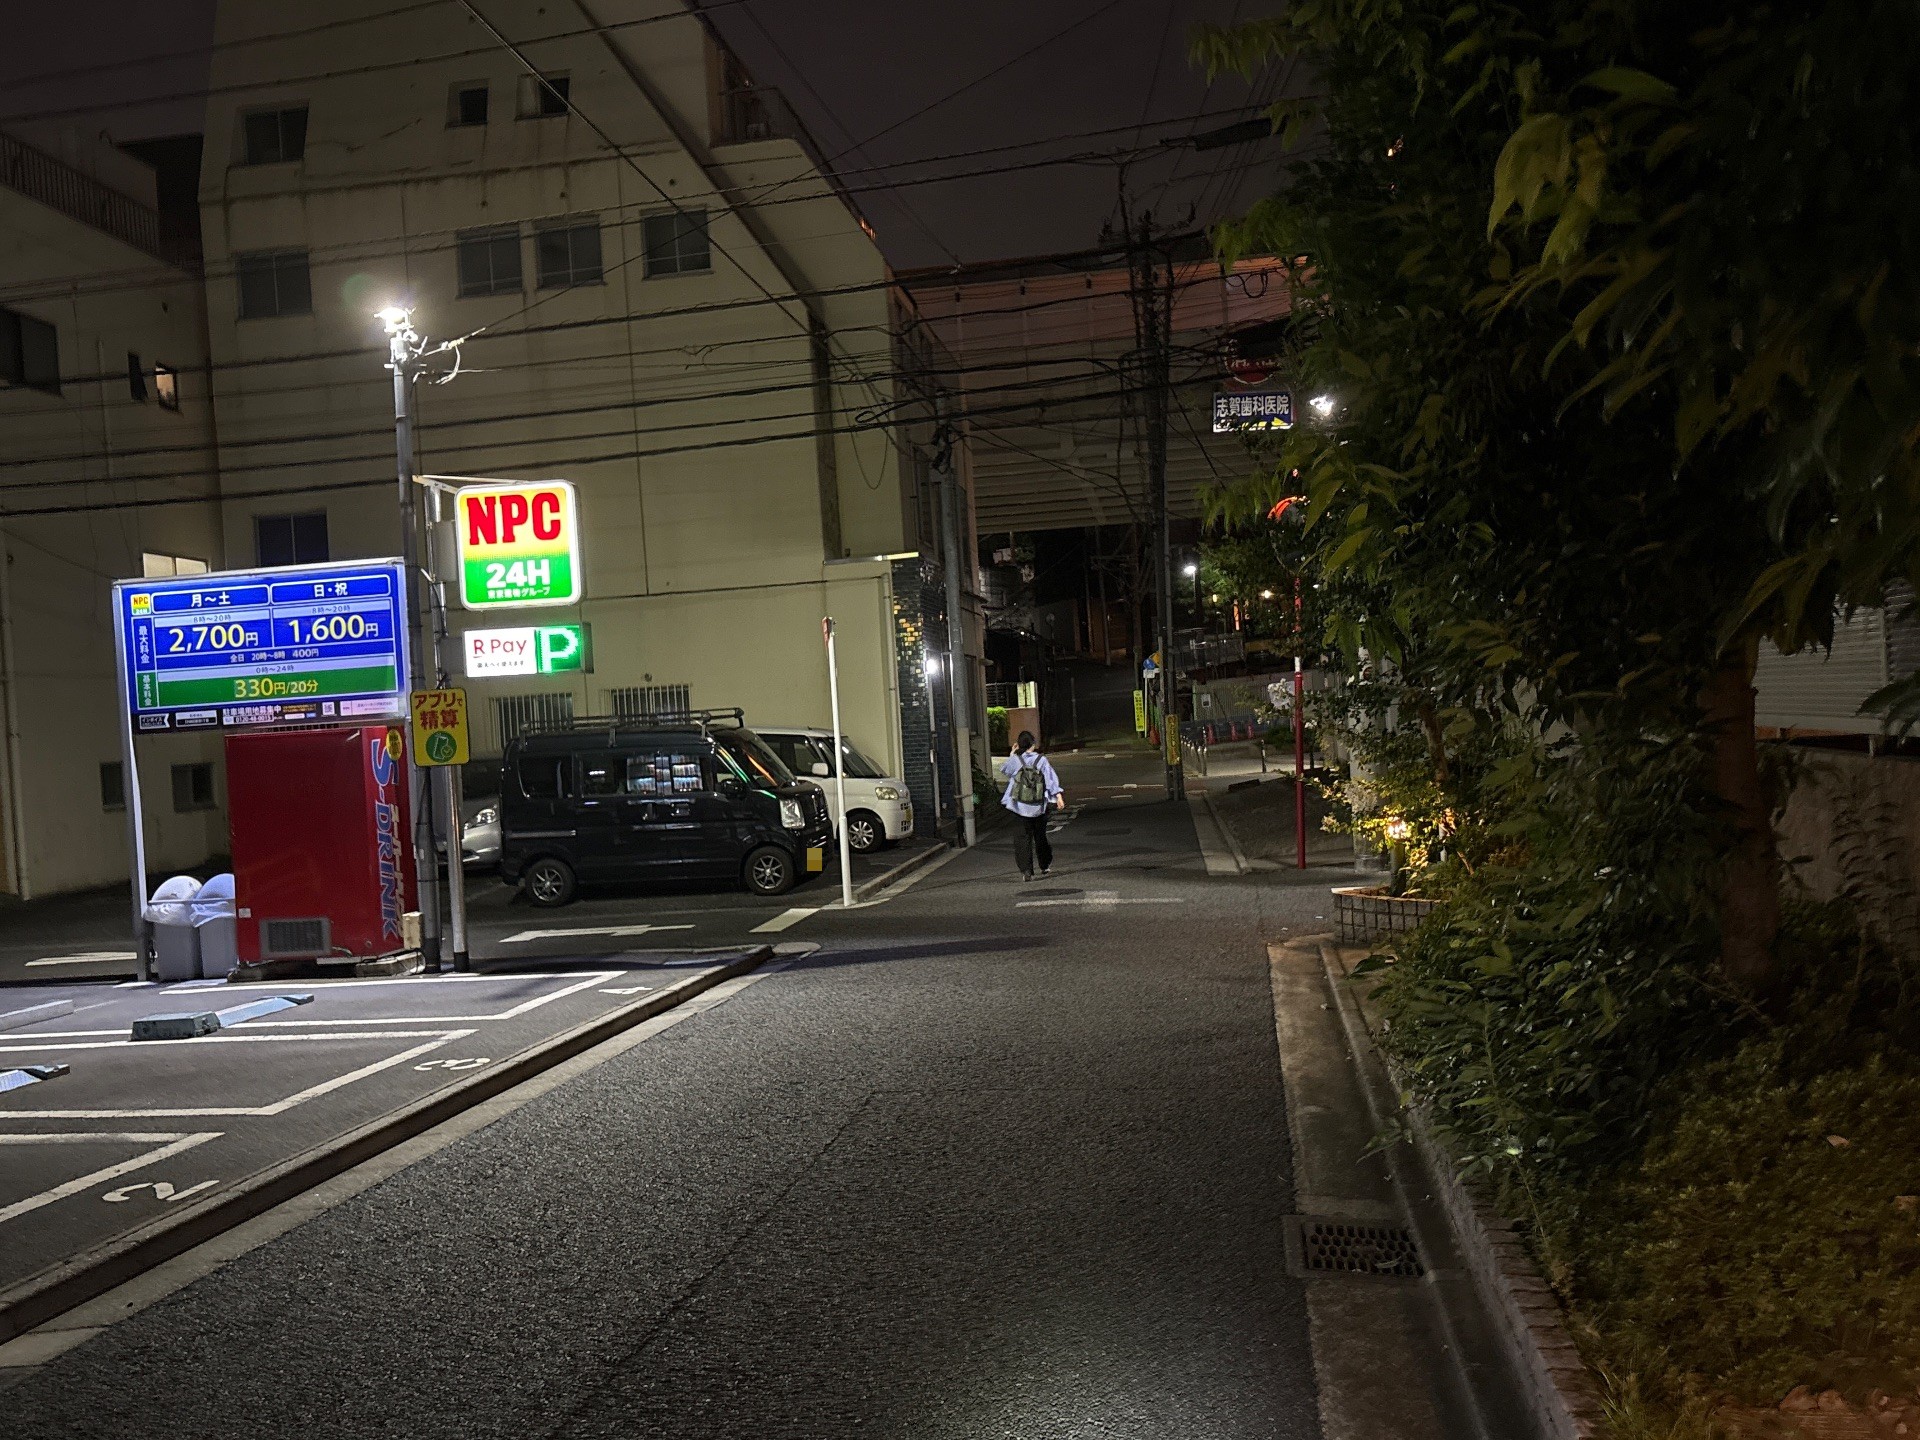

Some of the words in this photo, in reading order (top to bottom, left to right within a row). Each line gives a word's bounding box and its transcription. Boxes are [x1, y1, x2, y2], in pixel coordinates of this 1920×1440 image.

[1216, 395, 1289, 417] 志賀歯科医院
[466, 492, 561, 545] NPC
[486, 559, 550, 589] 24H
[133, 596, 148, 605] NPC
[191, 591, 231, 607] 月～土
[314, 582, 348, 598] 日・祝
[168, 624, 259, 653] 2,700円
[288, 614, 379, 644] 1,600円
[139, 625, 150, 664] 最大料金
[292, 648, 319, 659] 400円
[490, 639, 527, 656] Pay
[540, 628, 579, 672] P
[234, 677, 319, 699] 330円/20分
[414, 692, 463, 709] アプリで
[419, 709, 460, 731] 精算
[371, 738, 399, 941] S-DRINK
[101, 1179, 220, 1202] 2
